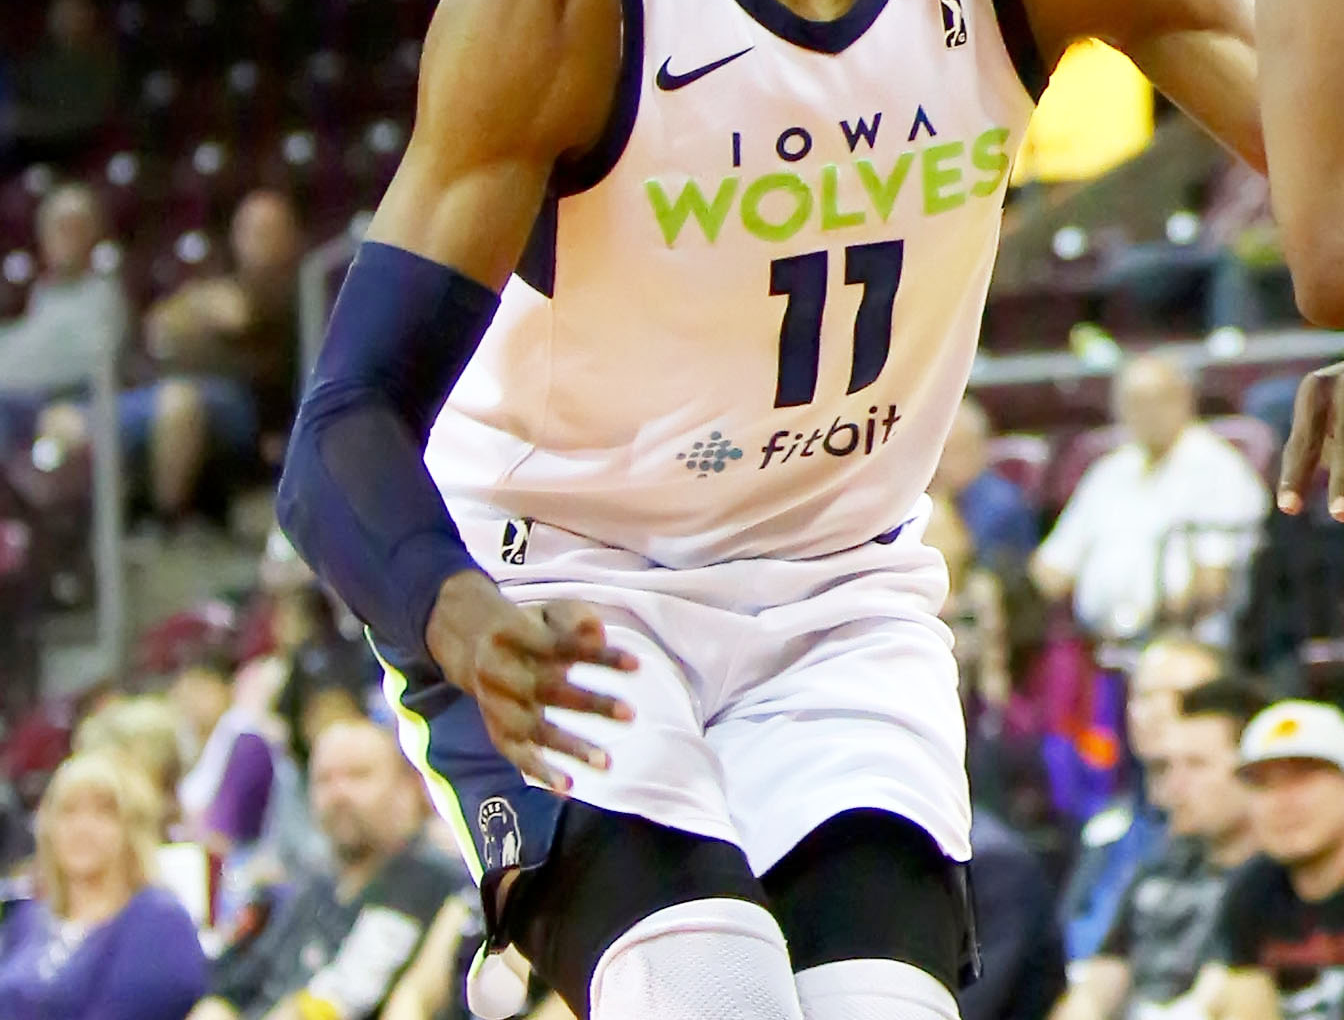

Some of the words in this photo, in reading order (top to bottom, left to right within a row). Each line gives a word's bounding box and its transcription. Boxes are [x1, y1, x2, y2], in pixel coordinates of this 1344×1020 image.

[732, 105, 937, 168] IOWA
[643, 127, 1010, 248] WOLVES
[768, 239, 904, 409] 11
[758, 404, 902, 469] fitbit
